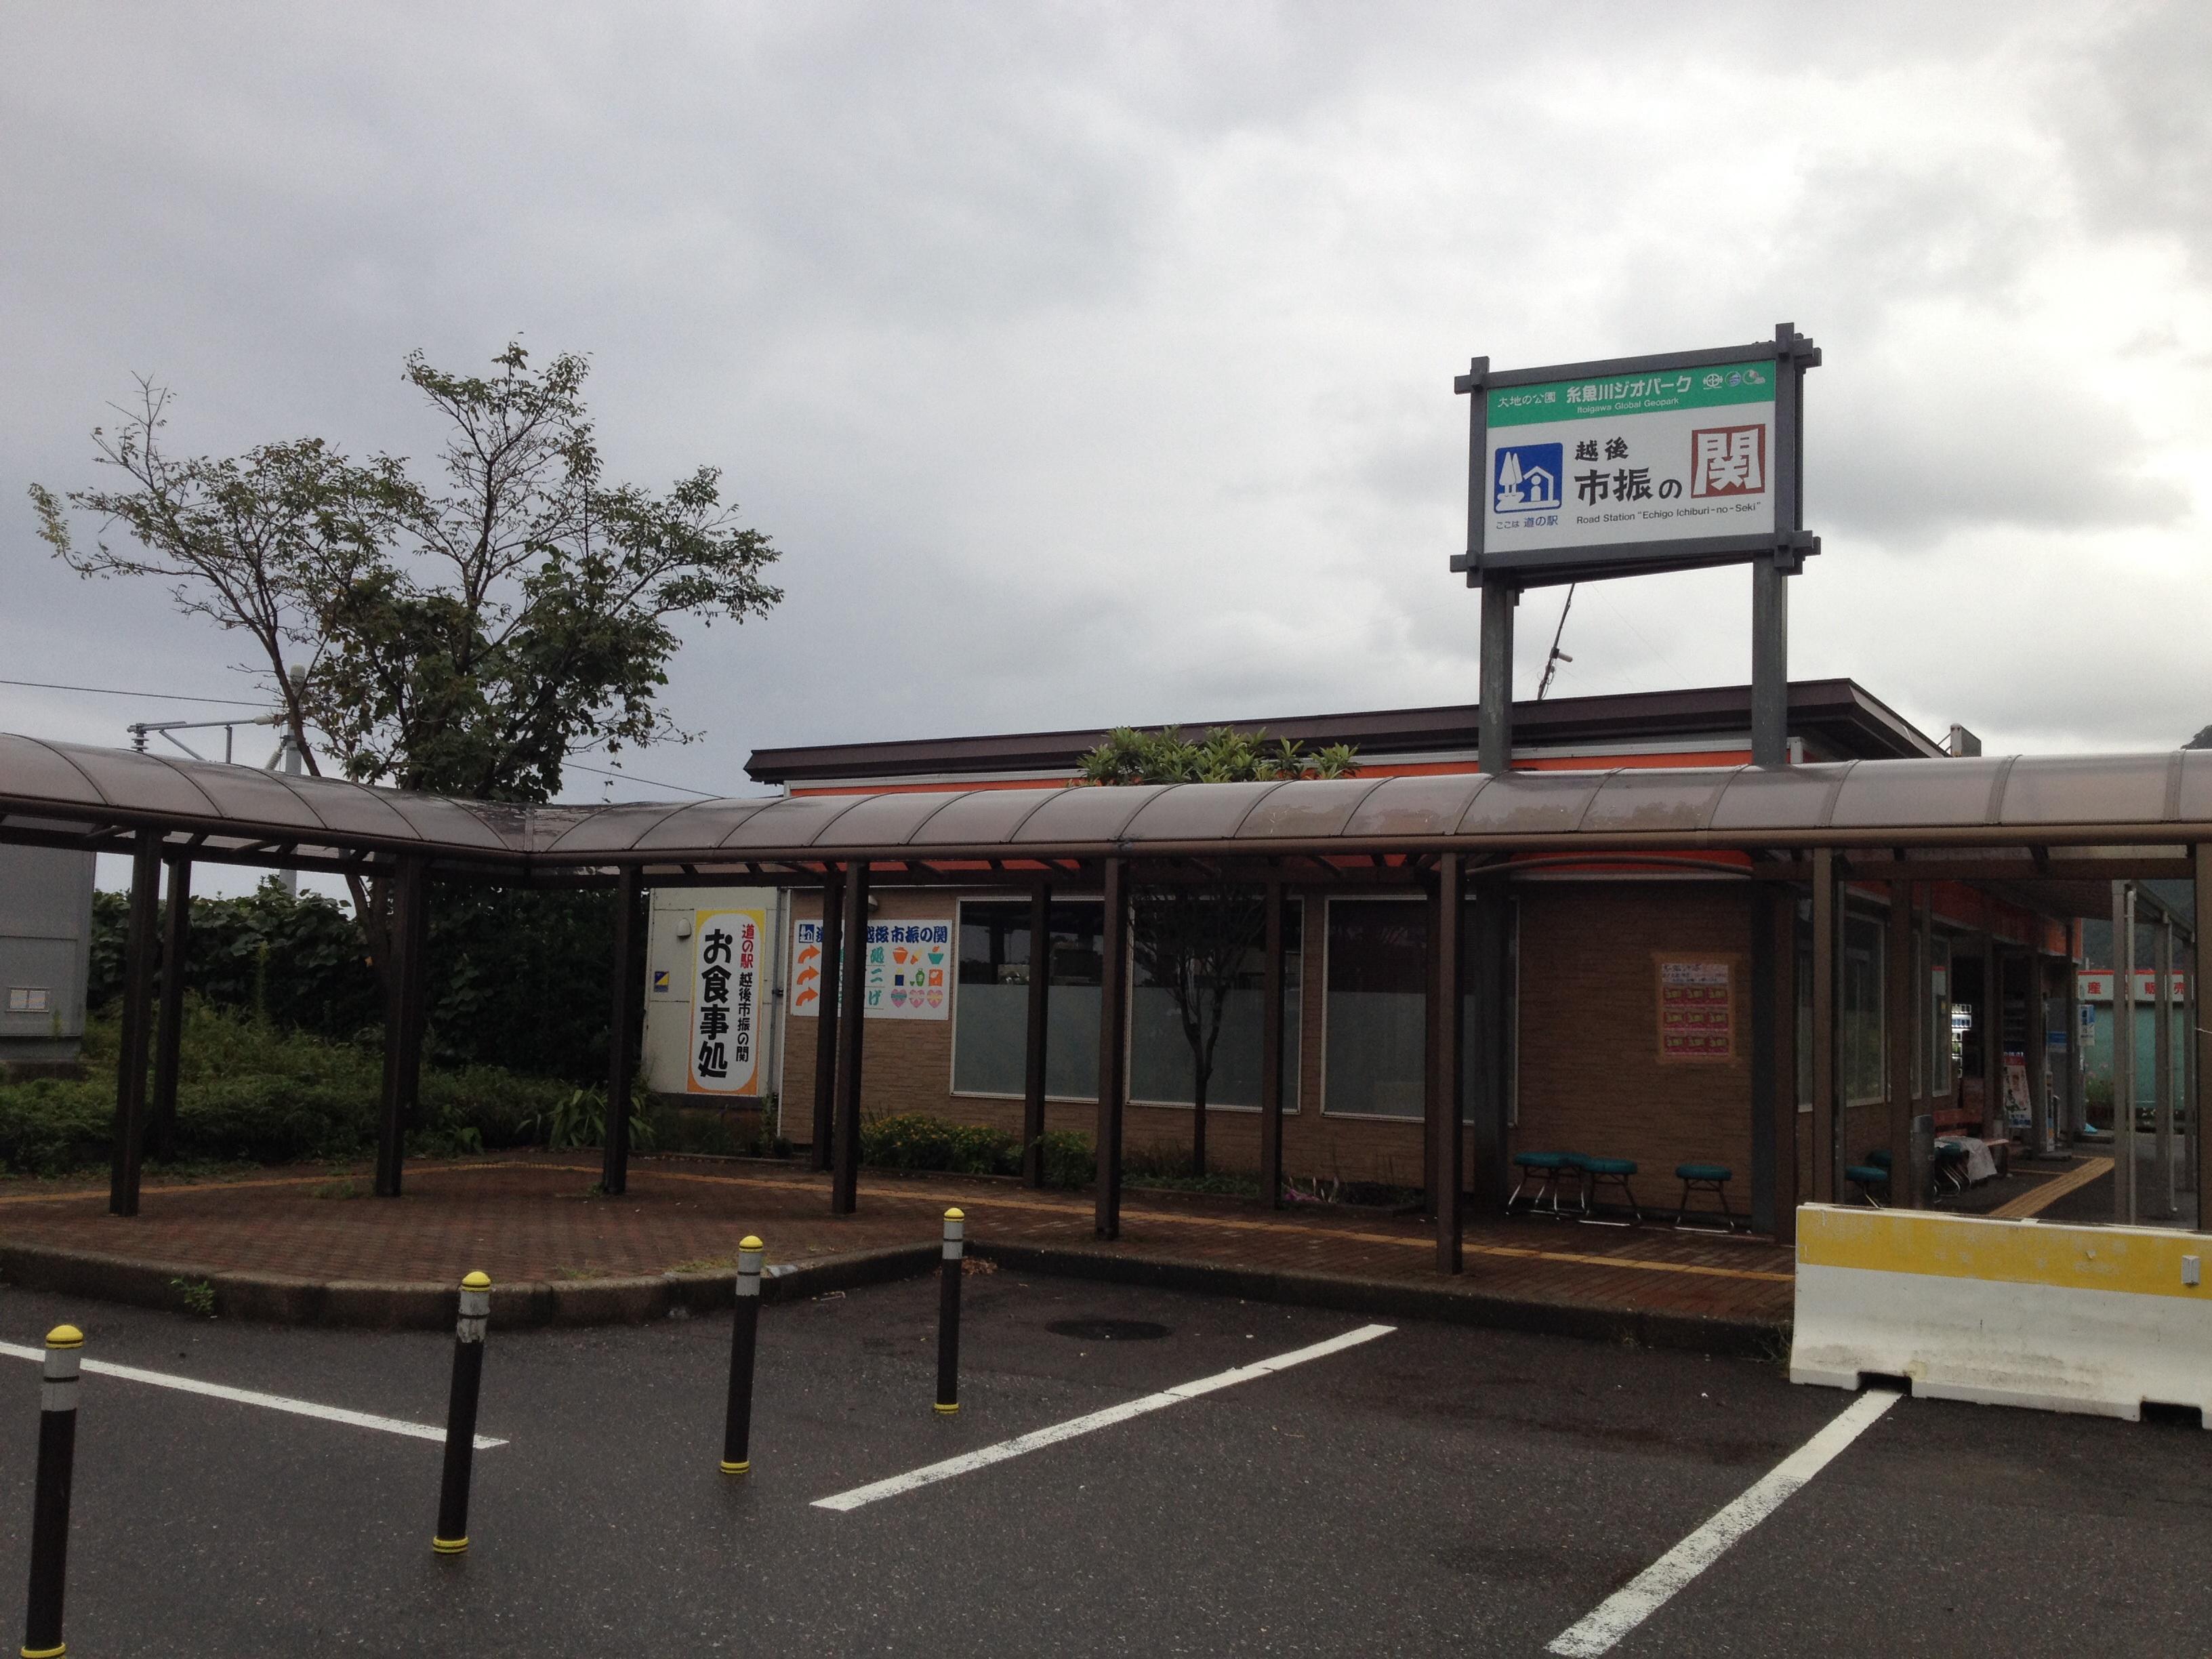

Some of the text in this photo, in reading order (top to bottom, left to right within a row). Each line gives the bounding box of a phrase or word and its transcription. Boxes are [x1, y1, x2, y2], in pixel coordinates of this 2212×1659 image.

[1498, 375, 1692, 407] 大地の公園 糸魚川ジオパーク
[1577, 397, 1679, 413] Itoigawa Global Geopark
[1575, 436, 1629, 462] 越後
[1496, 515, 1559, 529] ここは 道の駅
[1576, 516, 1600, 524] Road
[1603, 512, 1635, 523] Station
[698, 928, 733, 1078] お食事処
[736, 924, 755, 1063] 道の駅 越後市振の関
